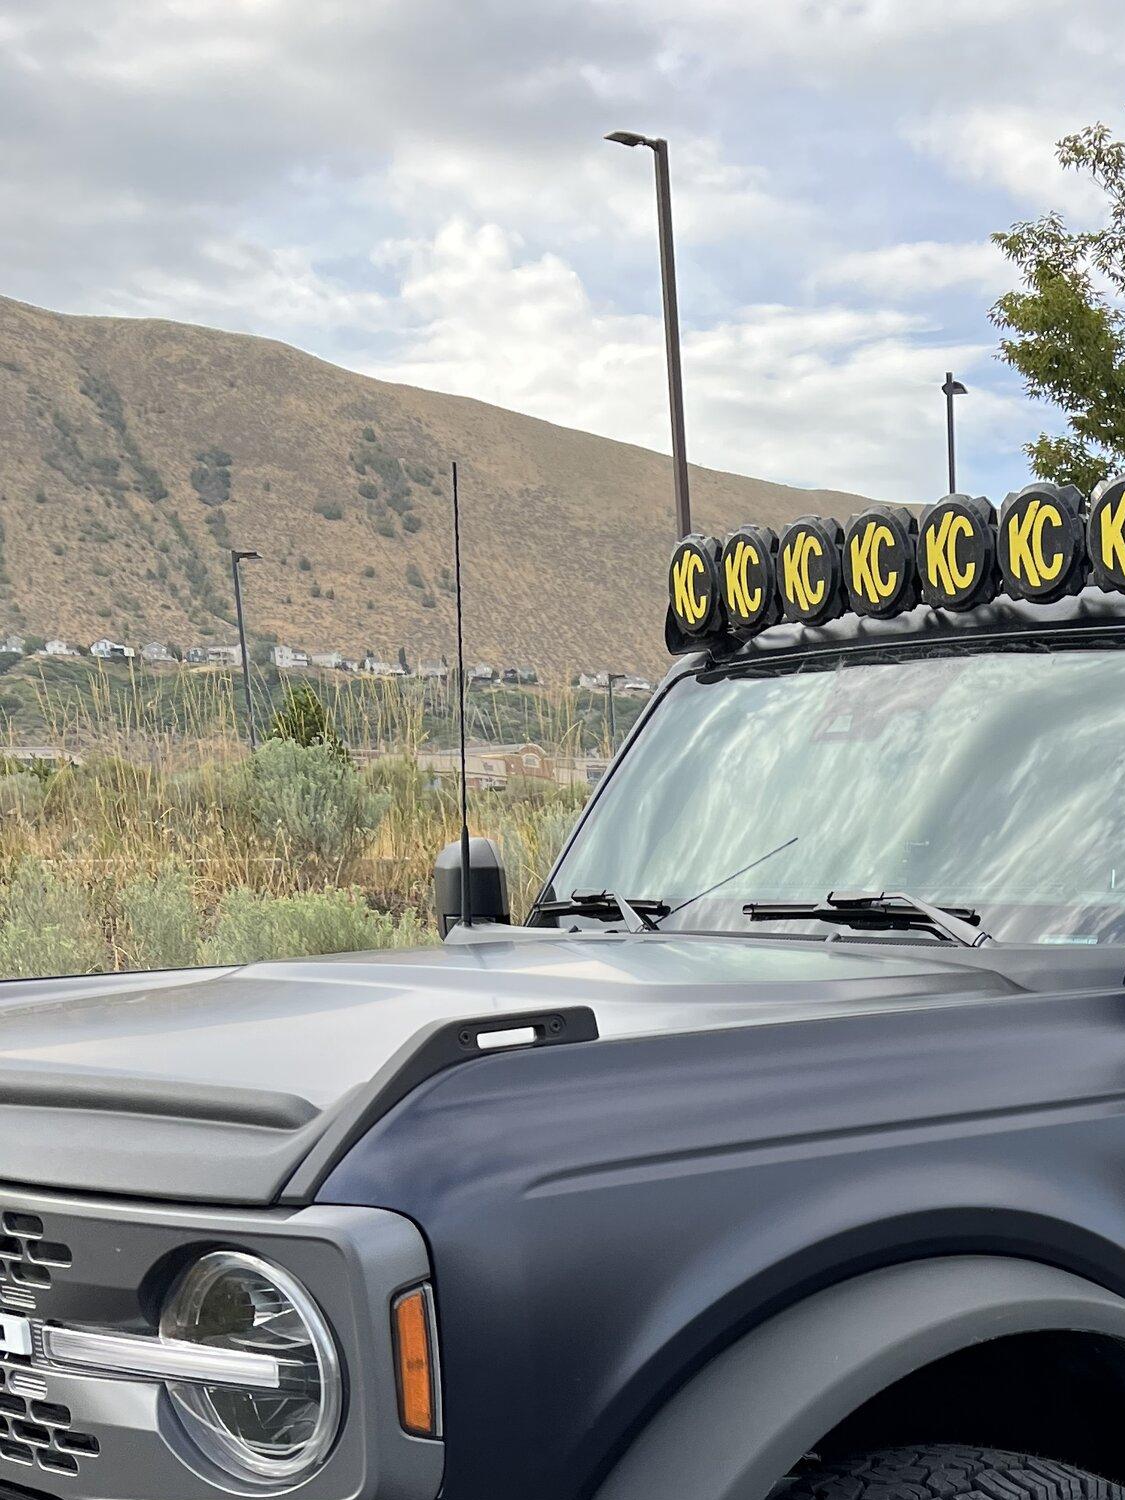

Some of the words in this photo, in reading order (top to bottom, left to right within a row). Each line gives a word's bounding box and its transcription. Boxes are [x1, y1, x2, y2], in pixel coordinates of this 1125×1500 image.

[725, 541, 762, 618] KC
[784, 532, 825, 615] KC
[851, 522, 896, 603] KC
[926, 511, 974, 595] KC
[1009, 501, 1063, 587] KC
[674, 550, 707, 624] KC
